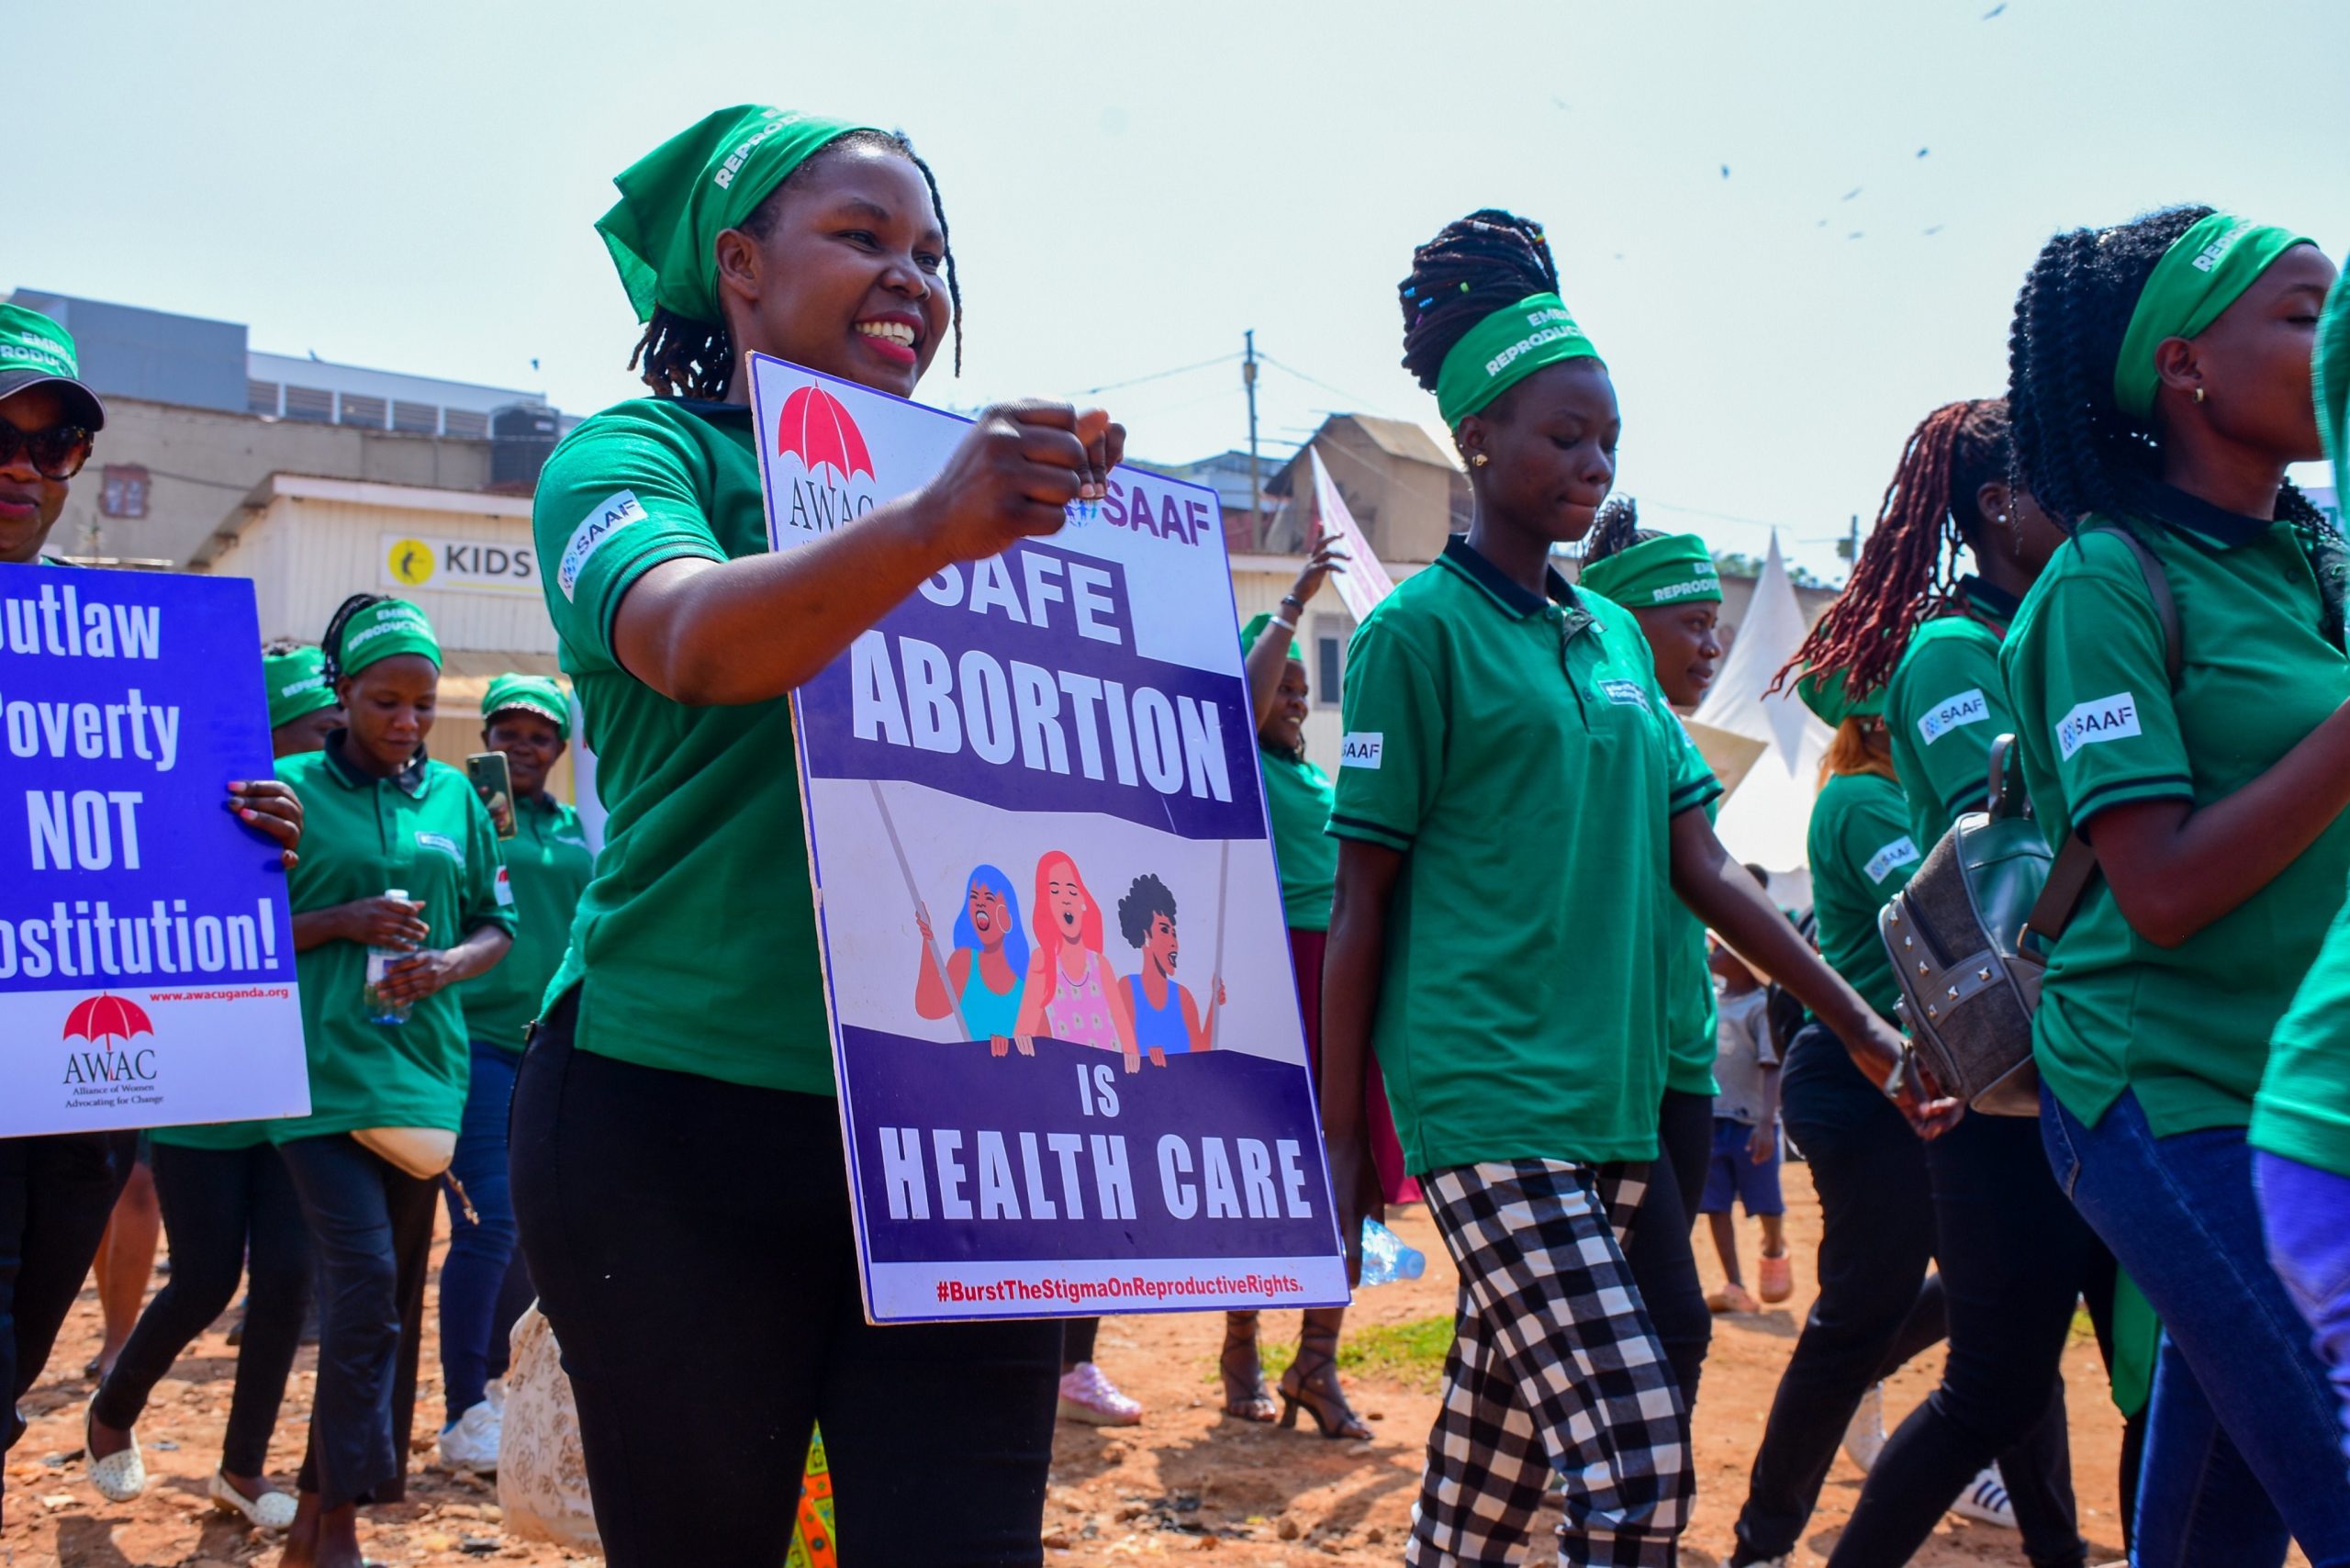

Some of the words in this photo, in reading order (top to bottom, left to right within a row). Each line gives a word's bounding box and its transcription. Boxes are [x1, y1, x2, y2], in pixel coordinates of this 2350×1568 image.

[576, 498, 635, 556] SAAF
[1102, 479, 1211, 546] SAAF
[443, 544, 532, 578] KIDS
[0, 584, 160, 659] utlaw
[0, 689, 180, 771] overty
[850, 629, 1233, 803] ABORTION
[1941, 698, 1982, 724] SAAF
[2076, 706, 2132, 735] SAAF
[26, 790, 143, 871] NOT
[150, 988, 289, 1002] www.awacuganda.org
[62, 1048, 158, 1084] AWAC
[65, 1098, 116, 1108] Advocating
[117, 1096, 129, 1105] for
[131, 1095, 164, 1105] Change
[73, 1087, 108, 1095] Alliance
[110, 1084, 120, 1093] of
[120, 1084, 155, 1092] Women
[1076, 1064, 1120, 1117] IS
[878, 1127, 1137, 1219] HEALTH
[1156, 1134, 1314, 1220] CARE
[936, 1273, 1304, 1304] #BurstTheStigmaOnReproductiveRights.
